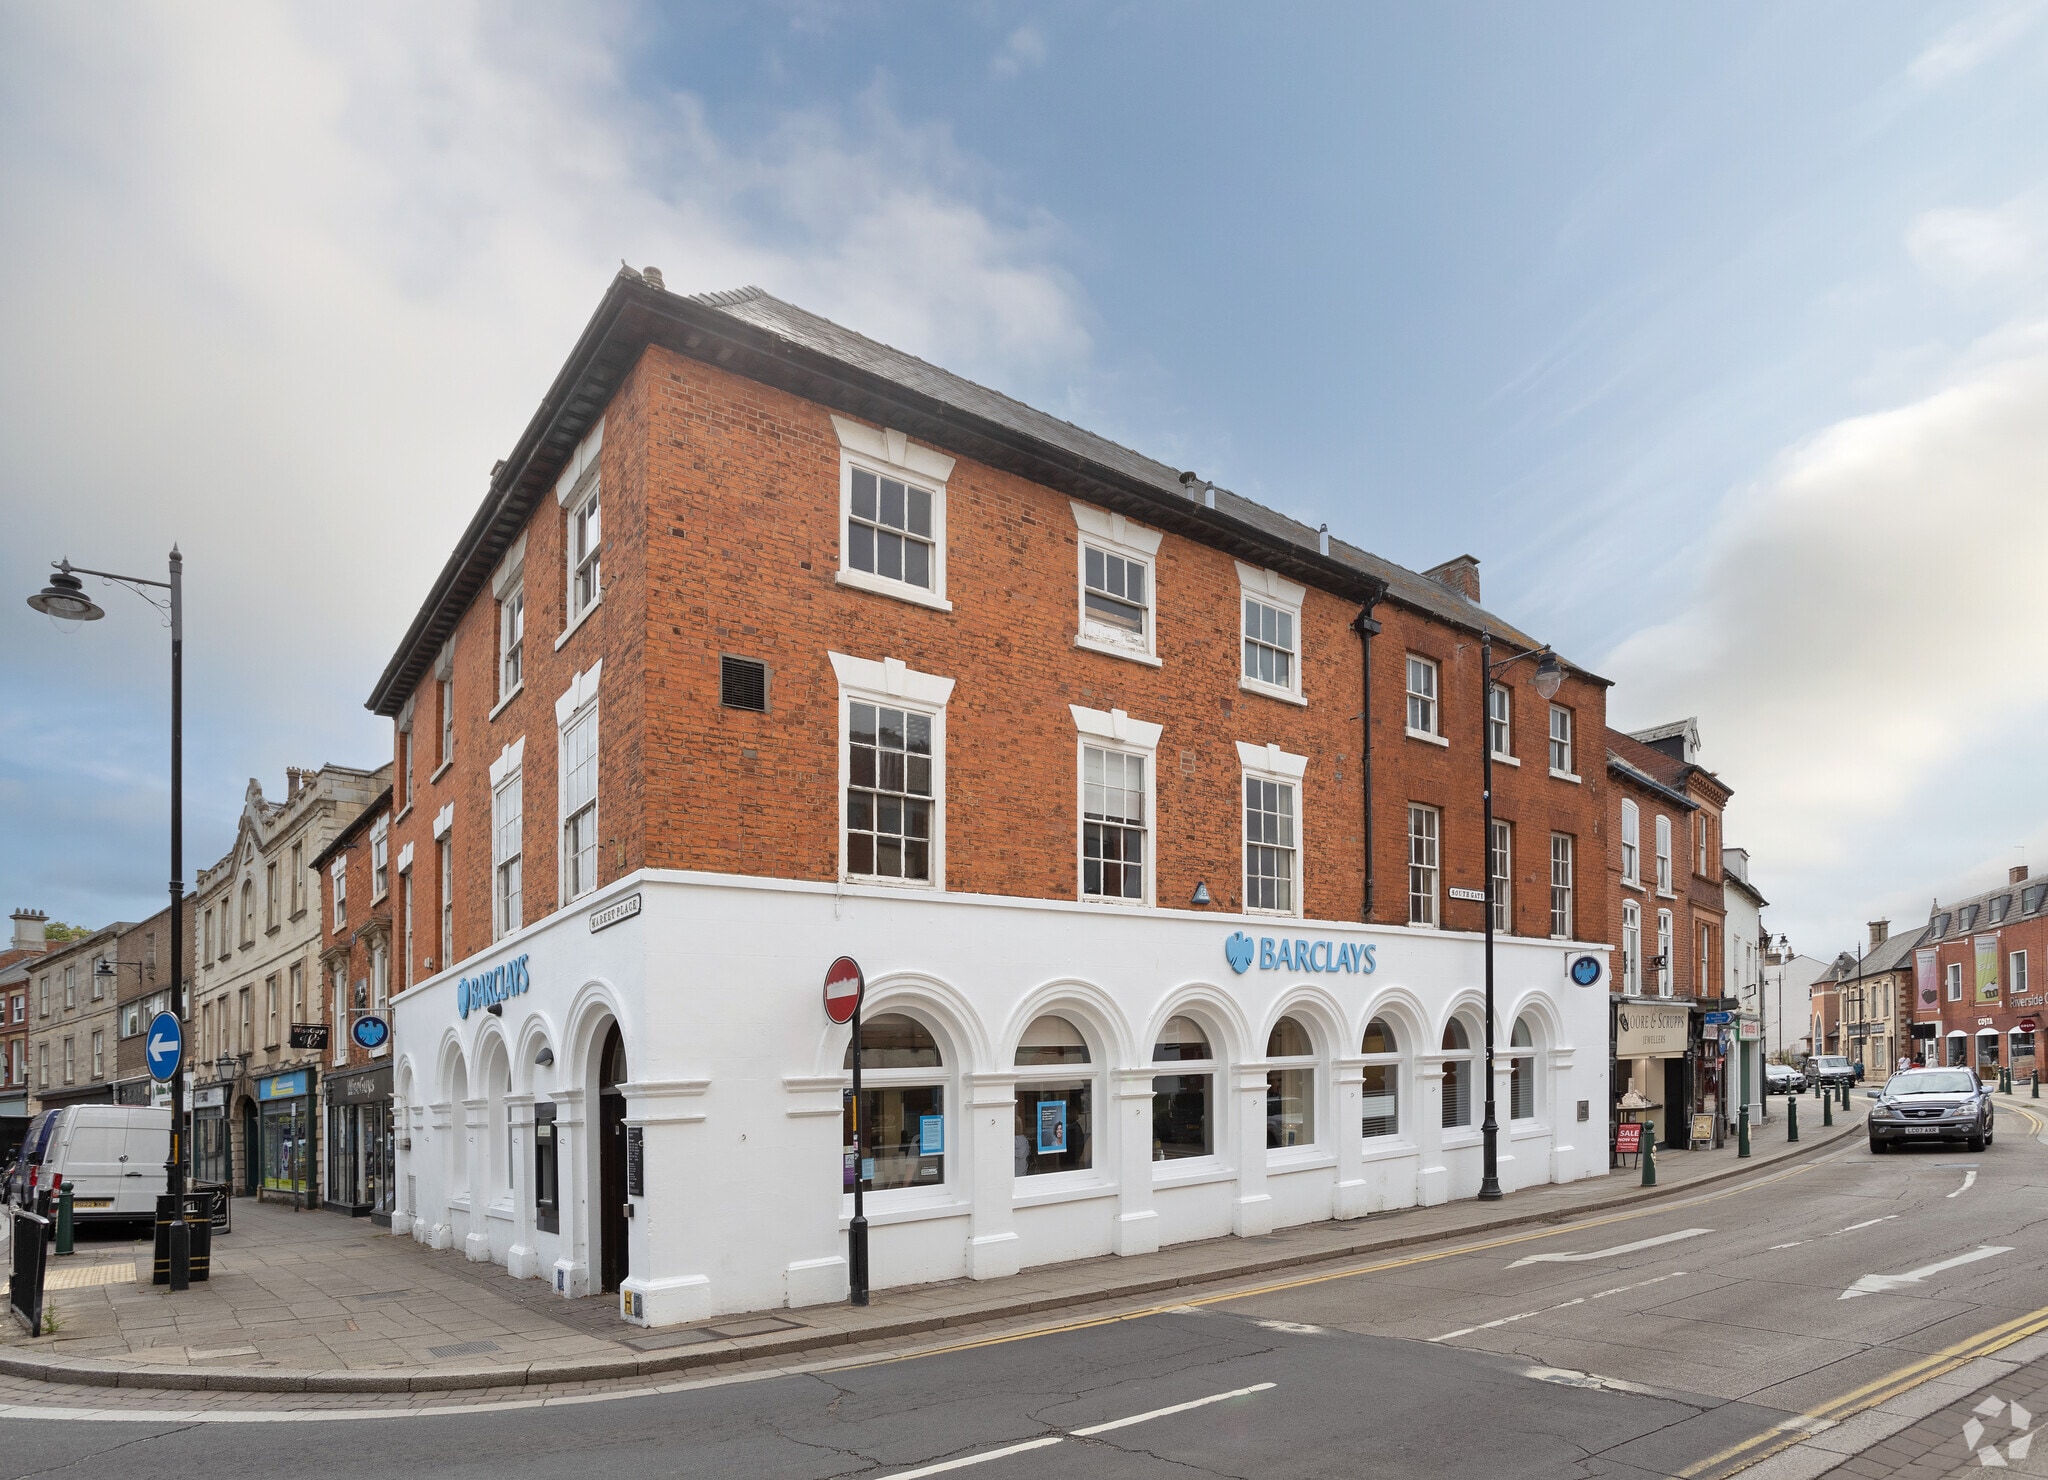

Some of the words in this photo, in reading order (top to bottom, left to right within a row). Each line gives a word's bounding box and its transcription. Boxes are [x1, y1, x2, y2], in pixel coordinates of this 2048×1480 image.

[1451, 890, 1470, 898] SOUTH
[1471, 892, 1484, 900] GATE
[592, 908, 615, 928] MARKET
[616, 899, 637, 917] PLACE
[1260, 937, 1377, 974] BARCLAYS
[470, 953, 529, 1011] BARCLAYS
[2010, 994, 2044, 1008] Riverside
[1978, 1017, 1993, 1026] COSTA
[1643, 1035, 1665, 1045] JEWELLERS
